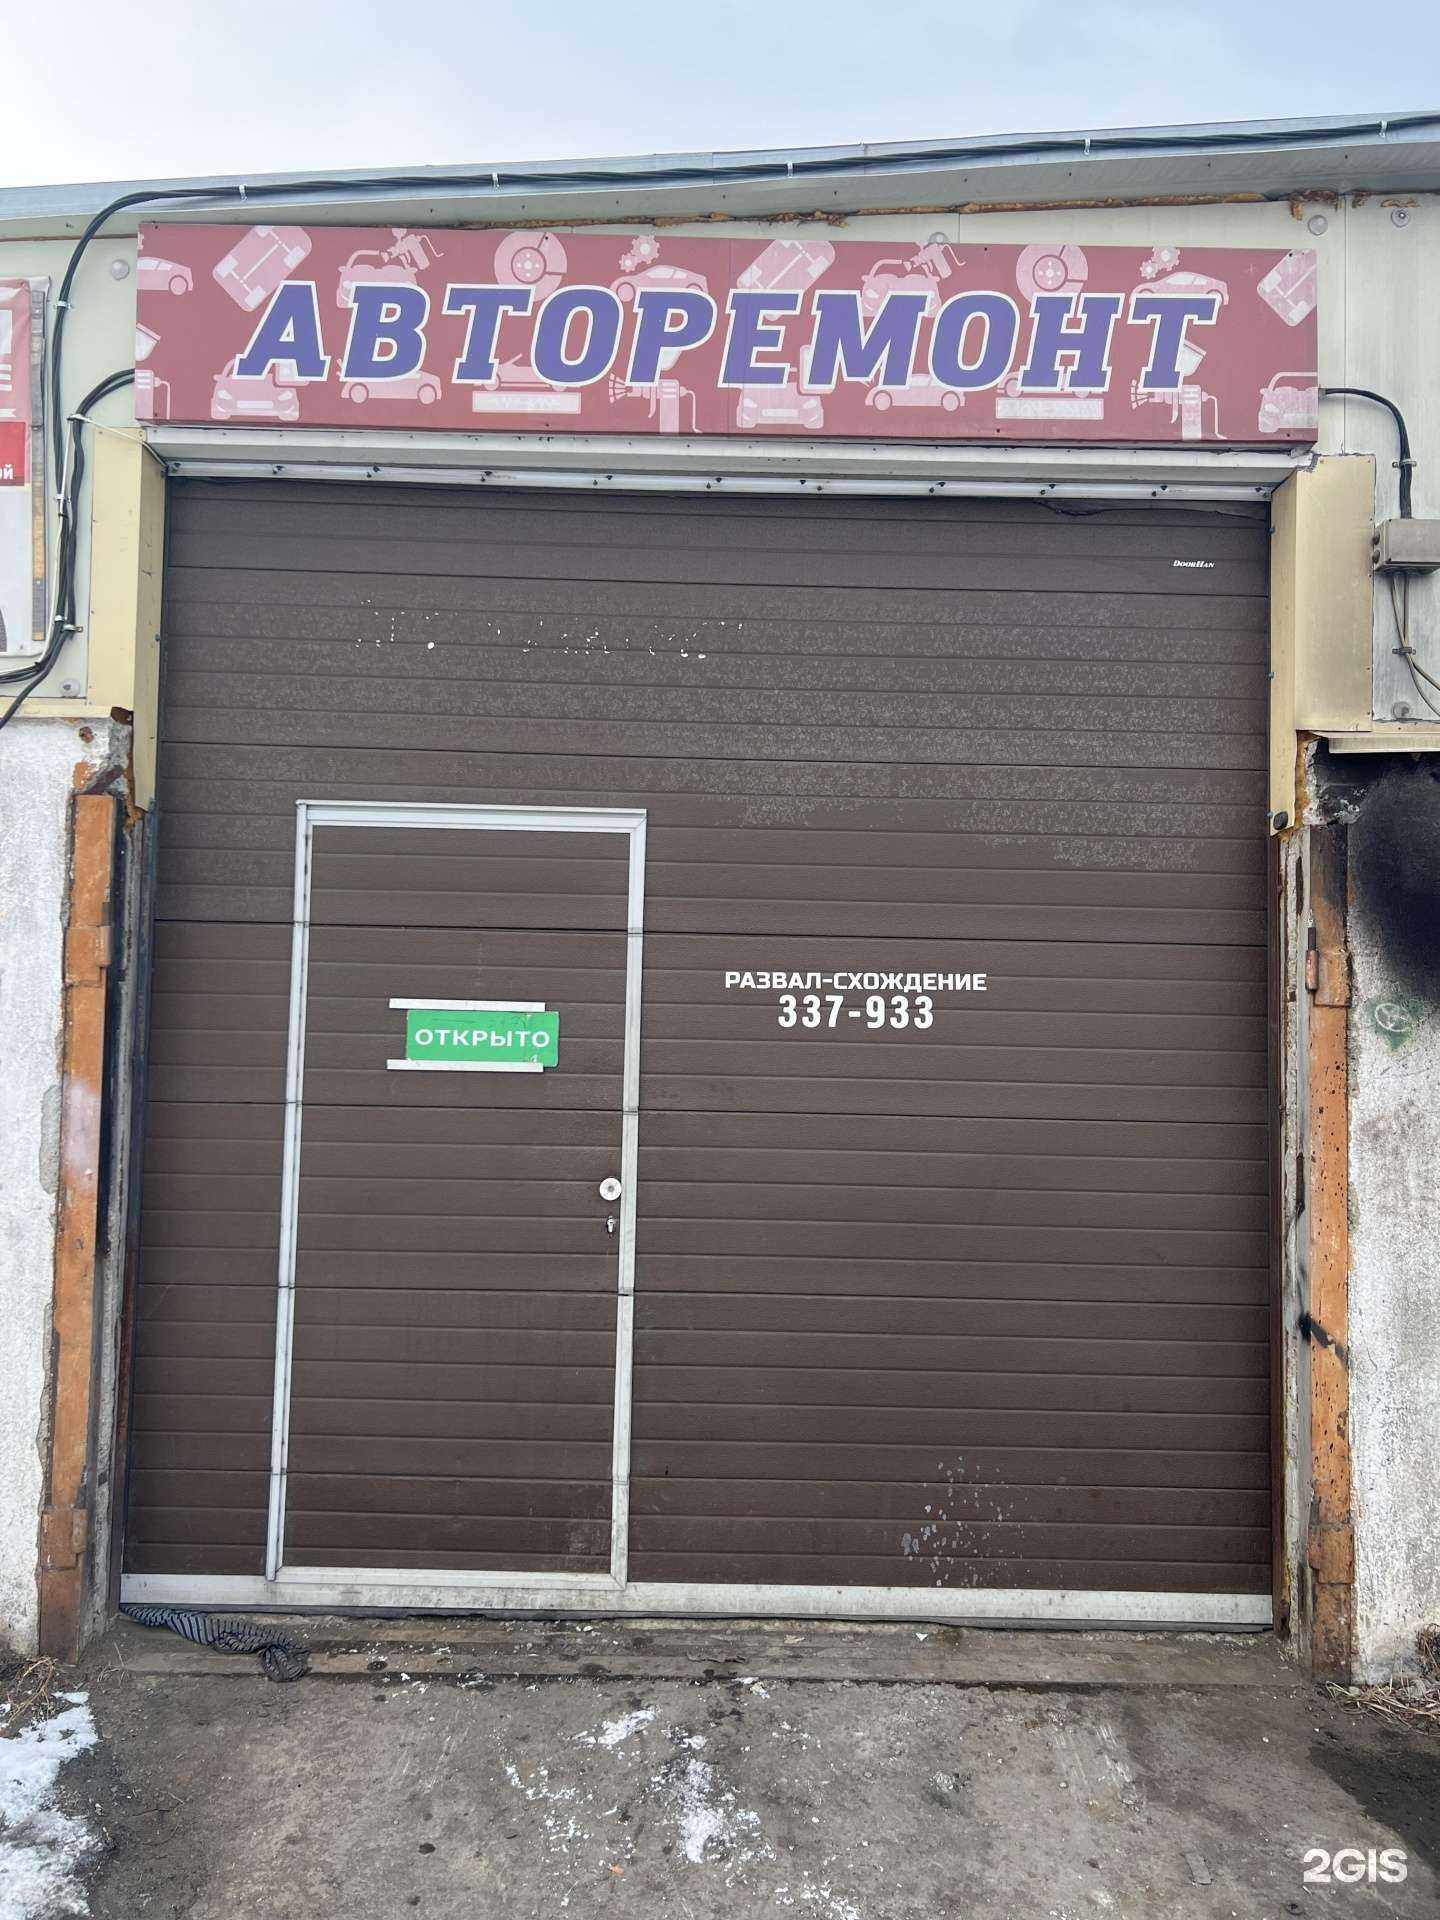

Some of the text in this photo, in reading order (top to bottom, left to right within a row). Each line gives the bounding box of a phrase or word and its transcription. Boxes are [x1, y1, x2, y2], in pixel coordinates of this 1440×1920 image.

[231, 280, 1221, 392] АВТОРЕМОНТ
[725, 971, 987, 993] РАЗВАЛ-СХОЖДЕНИЕ
[778, 994, 934, 1029] 337-933
[415, 1028, 550, 1048] ОТКРЫТО
